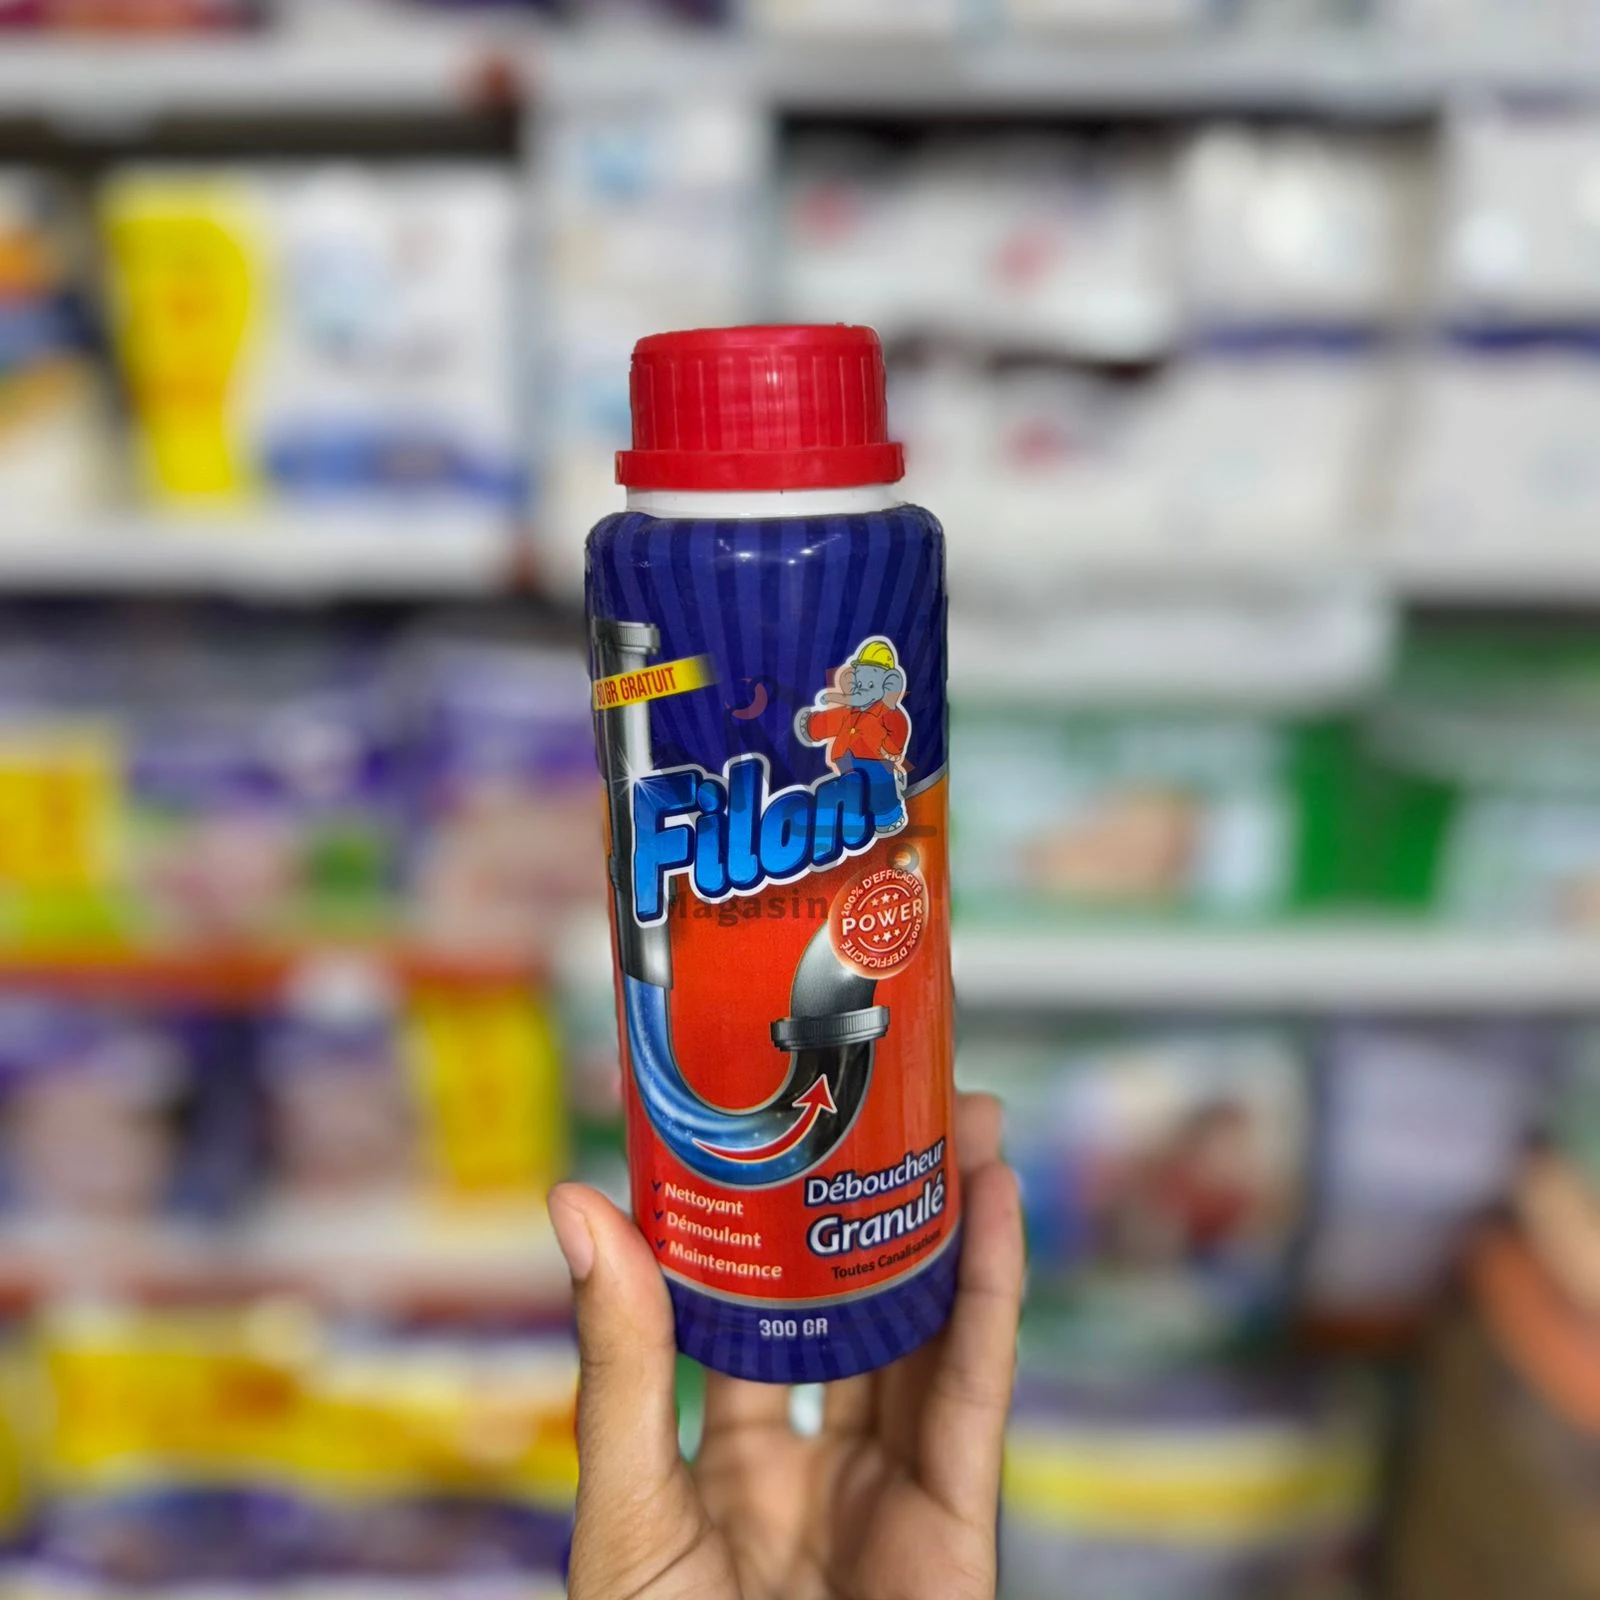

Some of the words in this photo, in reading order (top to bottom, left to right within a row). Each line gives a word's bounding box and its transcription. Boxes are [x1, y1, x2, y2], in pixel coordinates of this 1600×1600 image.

[604, 680, 619, 703] GR
[620, 667, 677, 700] GRATUIT
[633, 758, 875, 923] Filon
[841, 886, 863, 916] 100%
[842, 898, 923, 936] POWER
[906, 918, 922, 947] 100%
[807, 1139, 944, 1204] Déboucheur
[665, 1182, 744, 1216] Nettoyant
[809, 1172, 944, 1254] Granulé
[667, 1211, 761, 1247] Démoulant
[669, 1241, 782, 1278] Maintenance
[832, 1261, 875, 1279] Toutes
[759, 1319, 797, 1336] 300
[803, 1318, 828, 1336] GR
